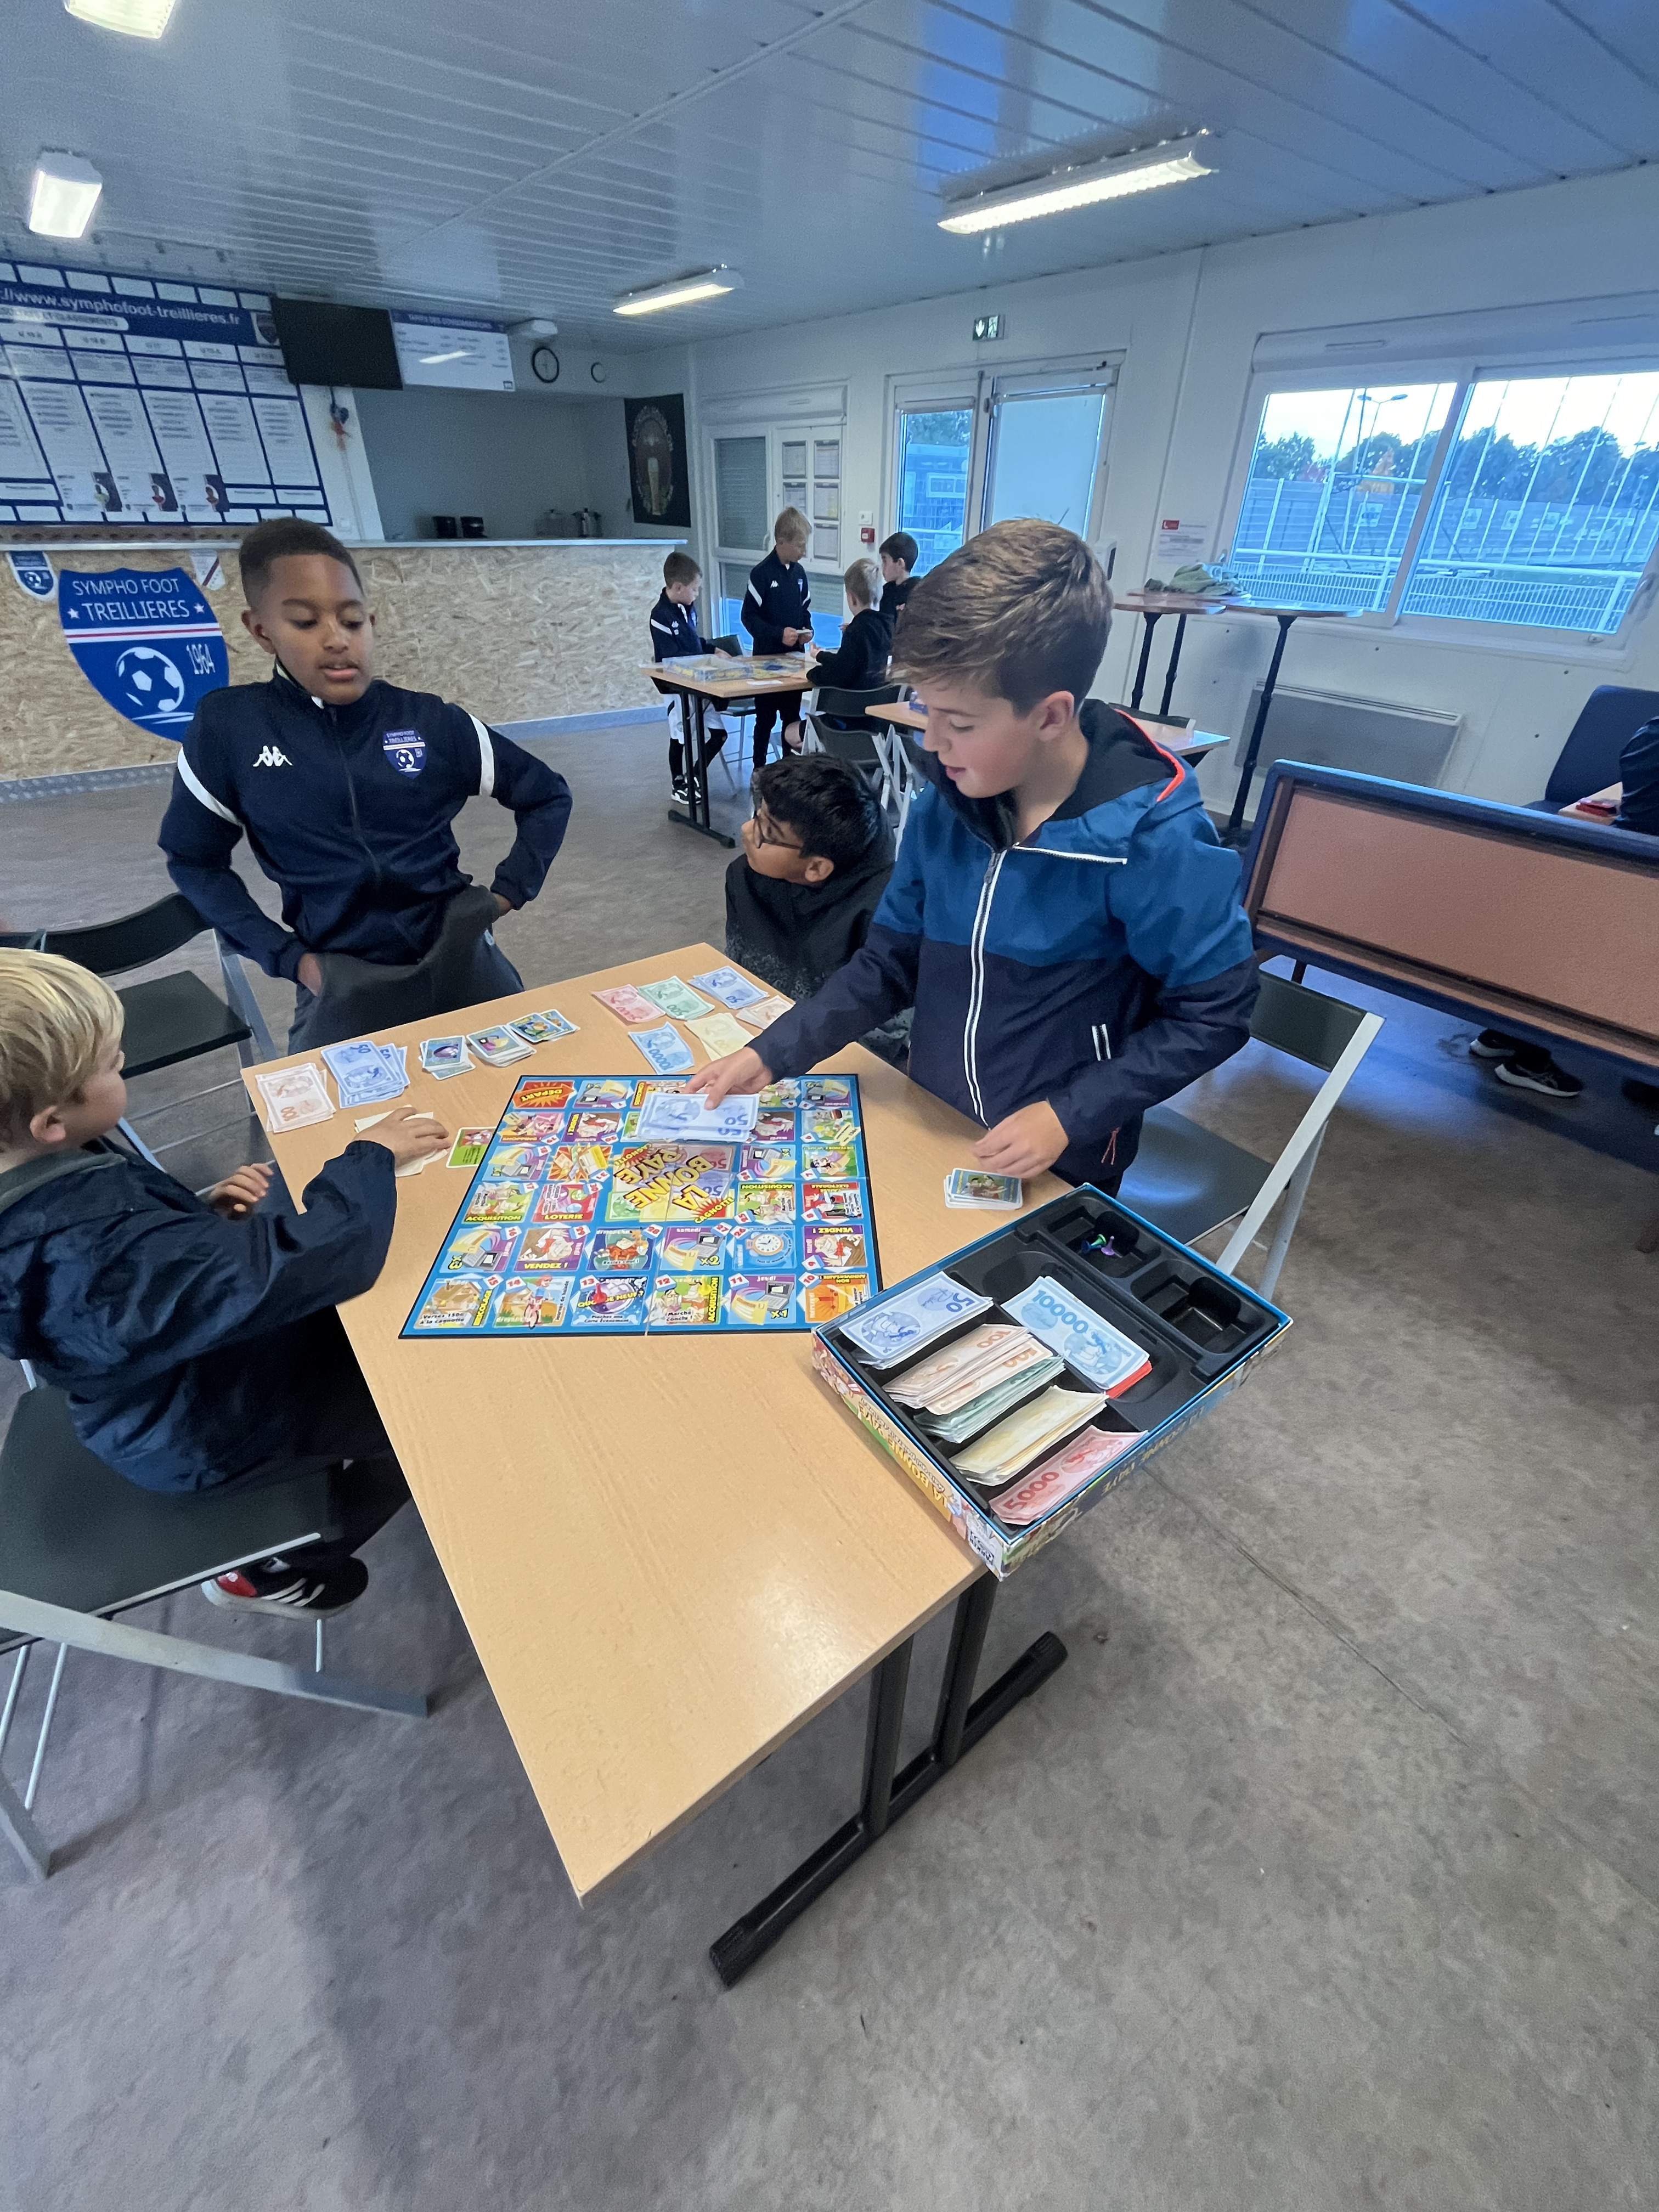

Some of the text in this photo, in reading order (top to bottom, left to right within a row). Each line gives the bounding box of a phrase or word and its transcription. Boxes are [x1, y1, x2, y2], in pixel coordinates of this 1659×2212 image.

[72, 578, 180, 596] SYMPHO FOOT
[81, 600, 190, 621] TREILLIERES
[186, 642, 216, 675] 1964
[726, 995, 744, 1004] 50
[350, 1043, 370, 1054] 50
[280, 1107, 300, 1122] 100
[724, 1113, 748, 1125] 50
[613, 1149, 682, 1184] PAYE
[623, 1155, 714, 1209] BONNE
[672, 1184, 710, 1210] LA
[694, 1197, 735, 1224] CAGNOTTE
[716, 1224, 729, 1233] 27
[733, 1228, 746, 1237] 26
[487, 1277, 499, 1286] 15
[507, 1279, 521, 1287] 14
[730, 1276, 743, 1284] 11
[803, 1274, 815, 1284] 10
[578, 1300, 596, 1308] QUO
[708, 1277, 719, 1321] ACQUISITION
[946, 1293, 975, 1312] 50
[1031, 1289, 1089, 1334] 10000
[976, 1330, 1012, 1348] 100
[1003, 1471, 1060, 1510] 5000
